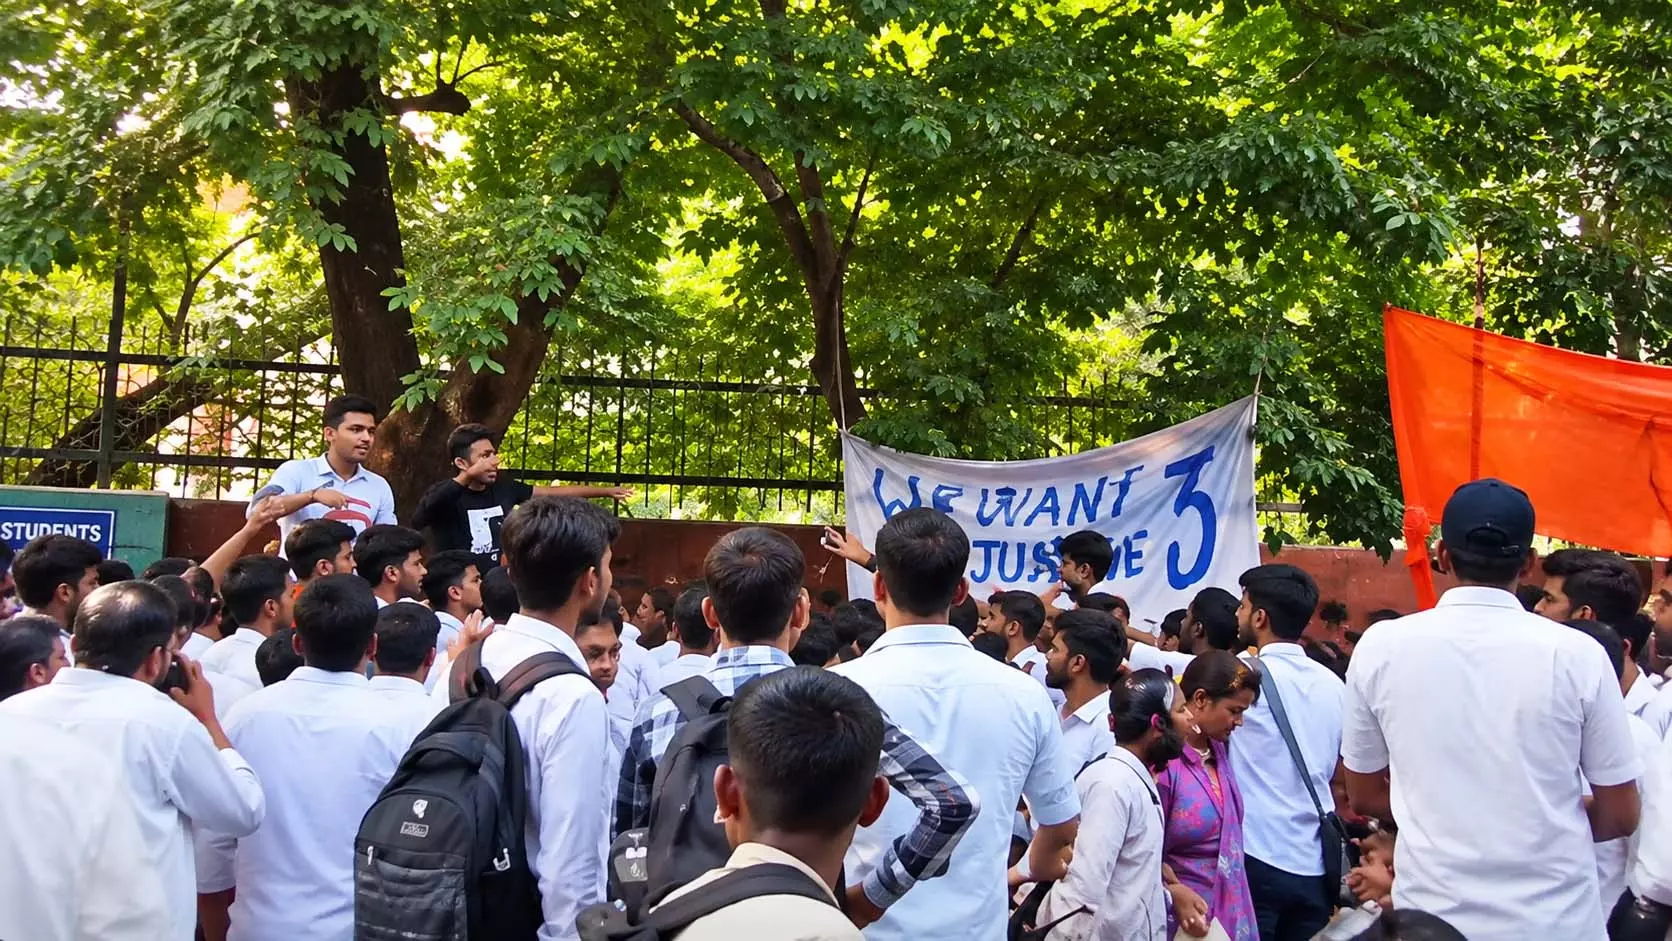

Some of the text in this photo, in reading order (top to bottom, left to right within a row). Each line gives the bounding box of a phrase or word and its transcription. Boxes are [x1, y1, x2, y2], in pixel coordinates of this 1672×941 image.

[873, 465, 1144, 527] WE WANT
[1164, 445, 1217, 590] 3
[1, 522, 101, 542] STUDENTS
